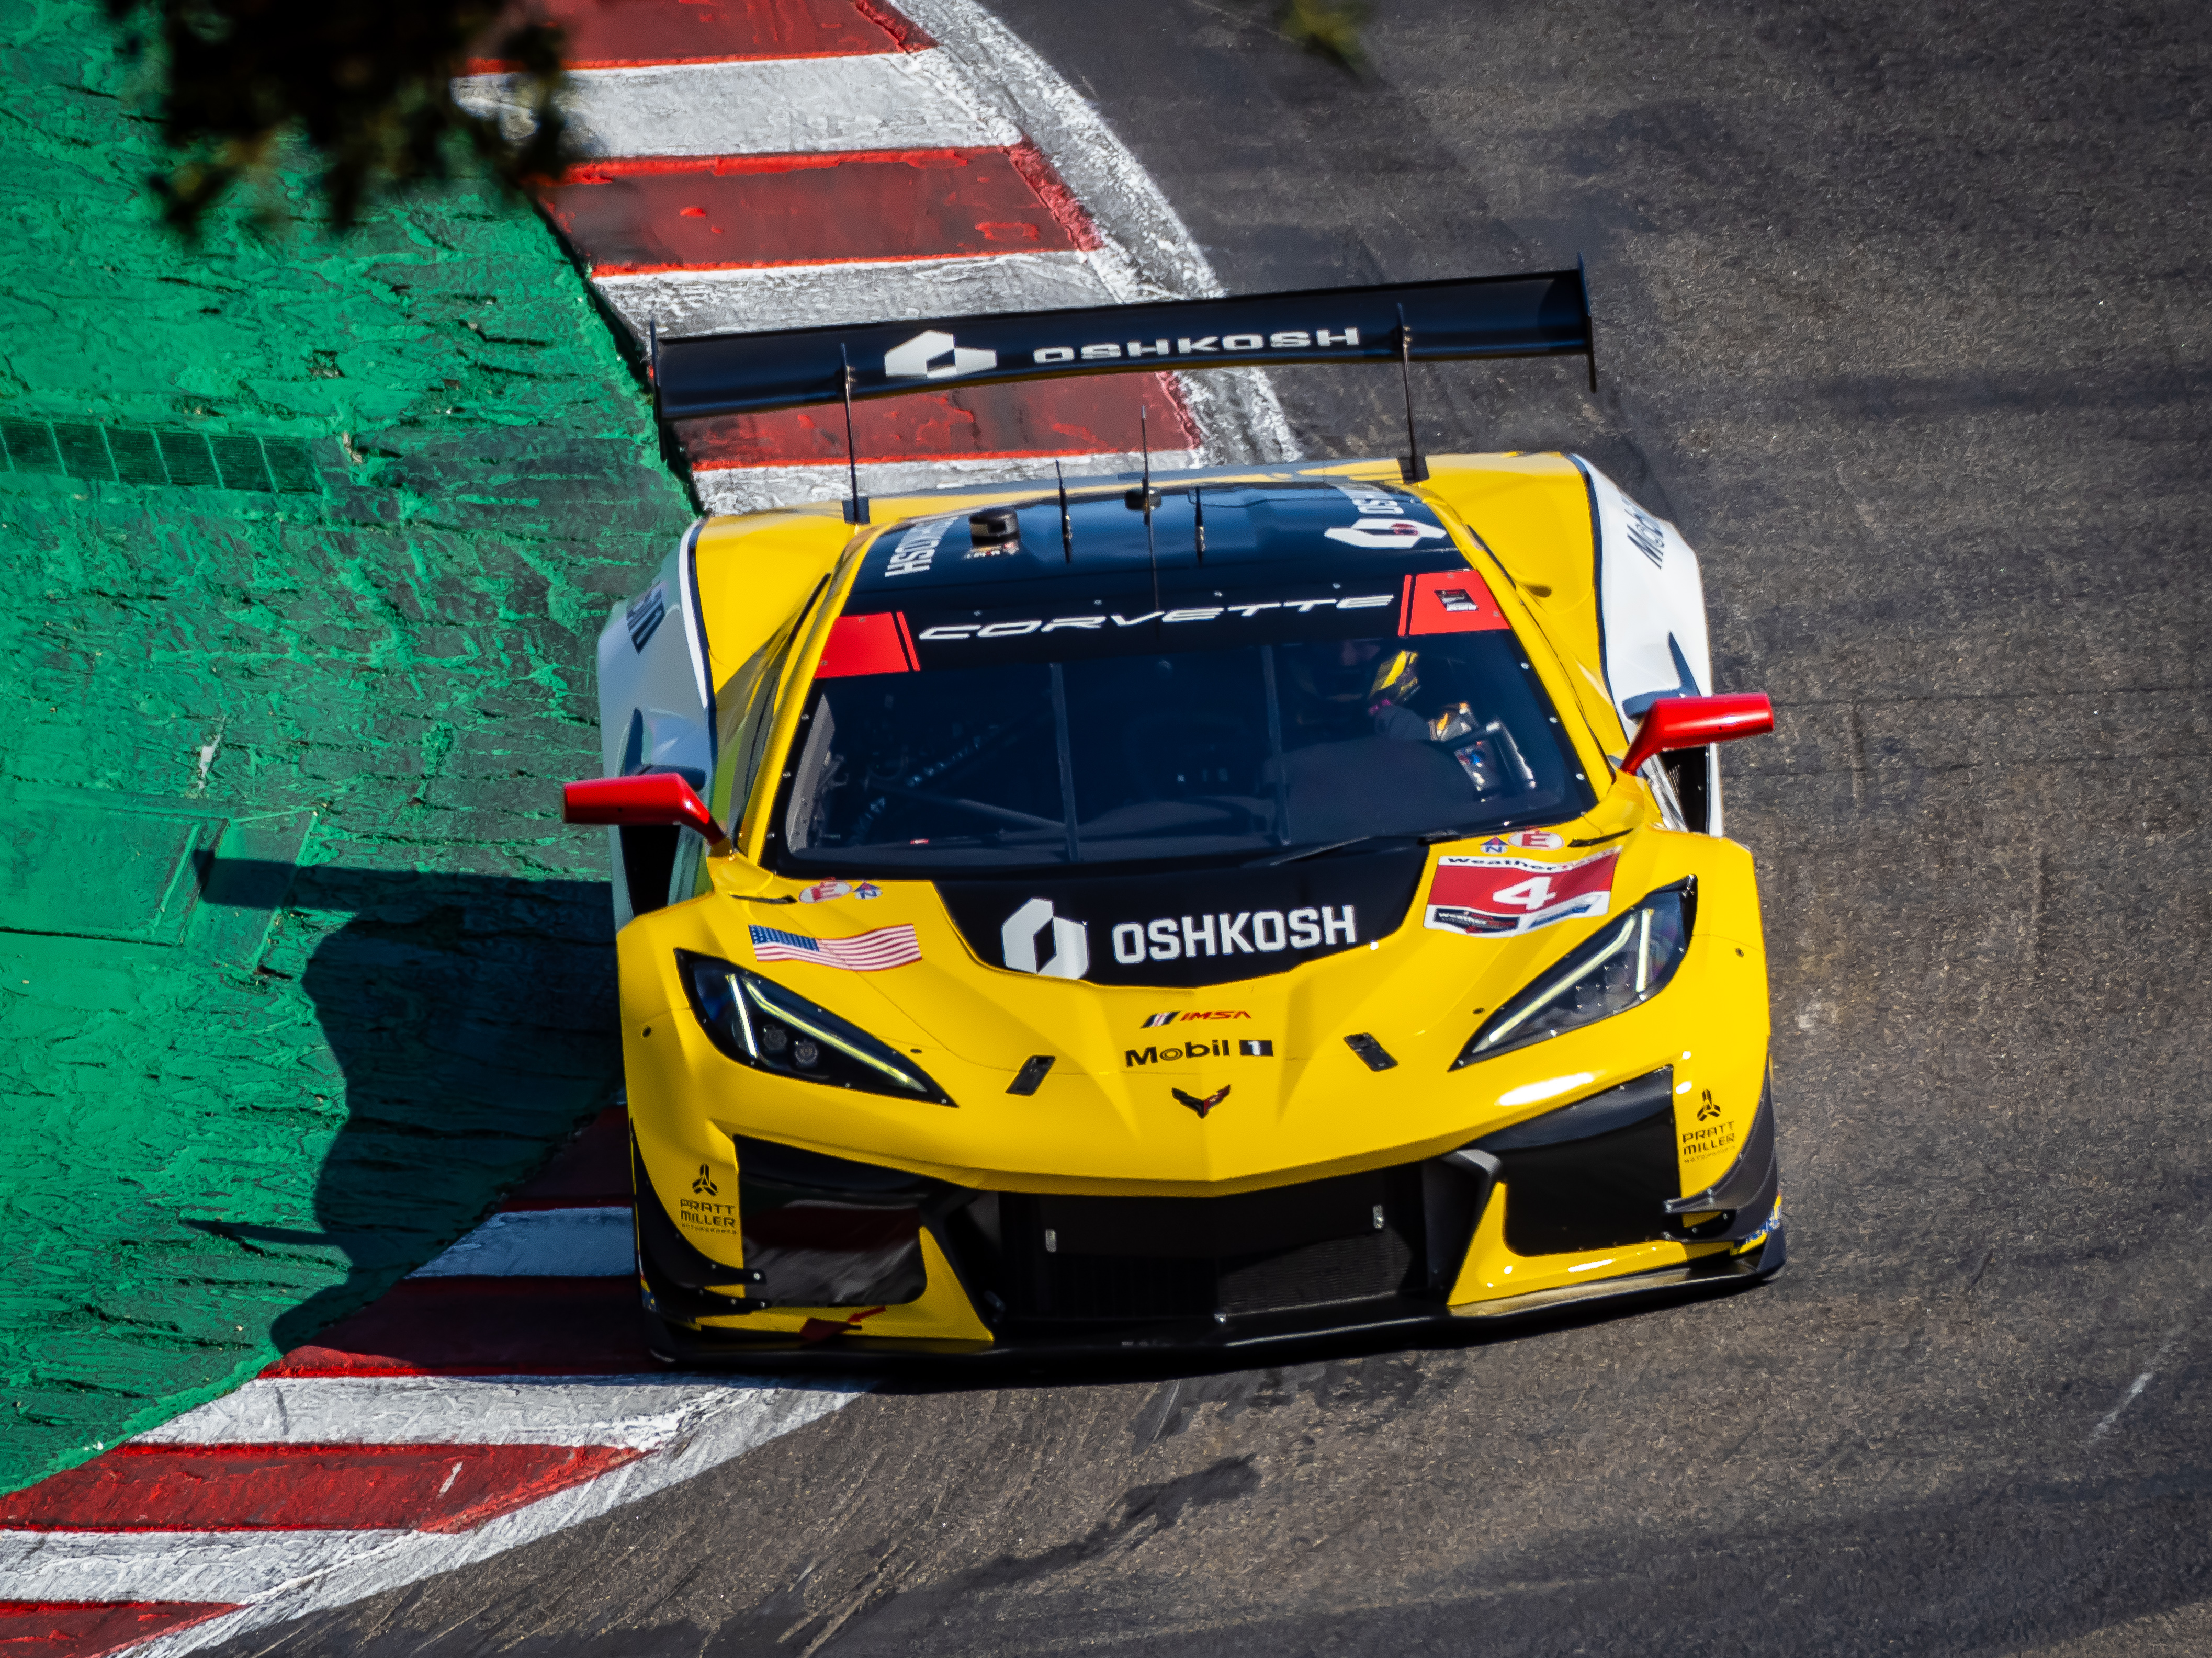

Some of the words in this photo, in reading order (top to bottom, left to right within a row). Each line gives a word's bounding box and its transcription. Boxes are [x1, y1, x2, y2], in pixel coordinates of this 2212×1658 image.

[1033, 327, 1360, 364] OSHKOSH
[919, 595, 1394, 640] CORVETTE
[1492, 876, 1557, 911] 4
[1112, 905, 1357, 964] OSHKOSH
[1179, 1010, 1252, 1021] IMSA
[1125, 1039, 1230, 1068] Mobil
[1683, 1122, 1734, 1143] PRATT
[1683, 1133, 1735, 1155] MILLER
[680, 1199, 735, 1214] PRATT
[681, 1210, 736, 1227] MILLER
